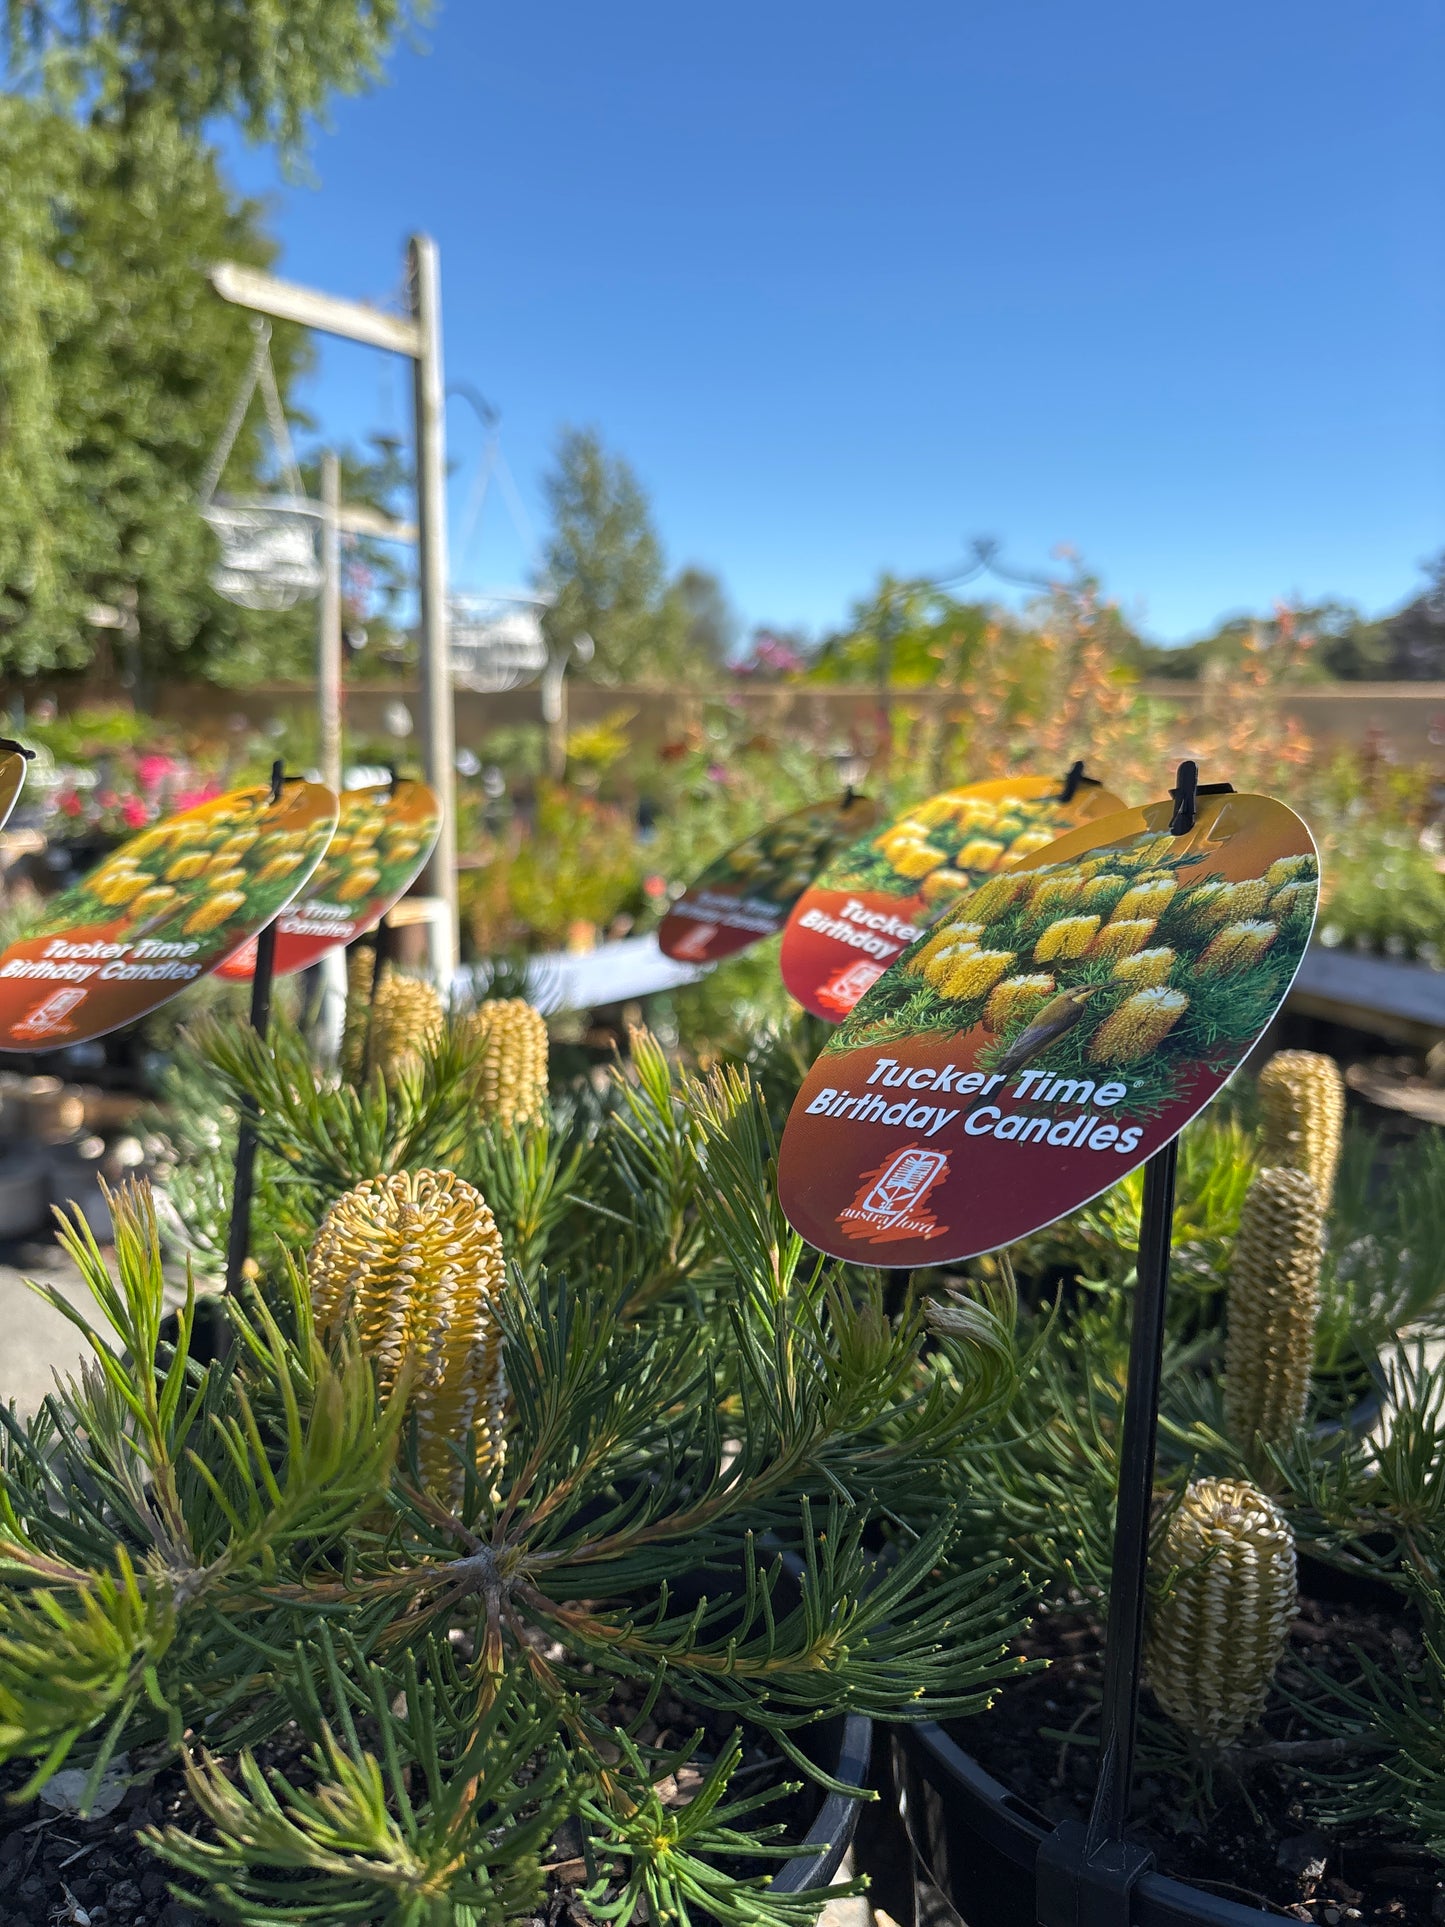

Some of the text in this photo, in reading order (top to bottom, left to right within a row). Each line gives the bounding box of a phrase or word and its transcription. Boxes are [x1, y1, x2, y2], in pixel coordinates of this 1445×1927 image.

[798, 909, 899, 960] Birthday
[840, 899, 926, 943] Tucker
[43, 939, 134, 959] Tucker
[0, 959, 203, 984] Birthday Candles
[865, 1058, 1008, 1096] Tucker
[804, 1088, 1144, 1154] Birthday Candles
